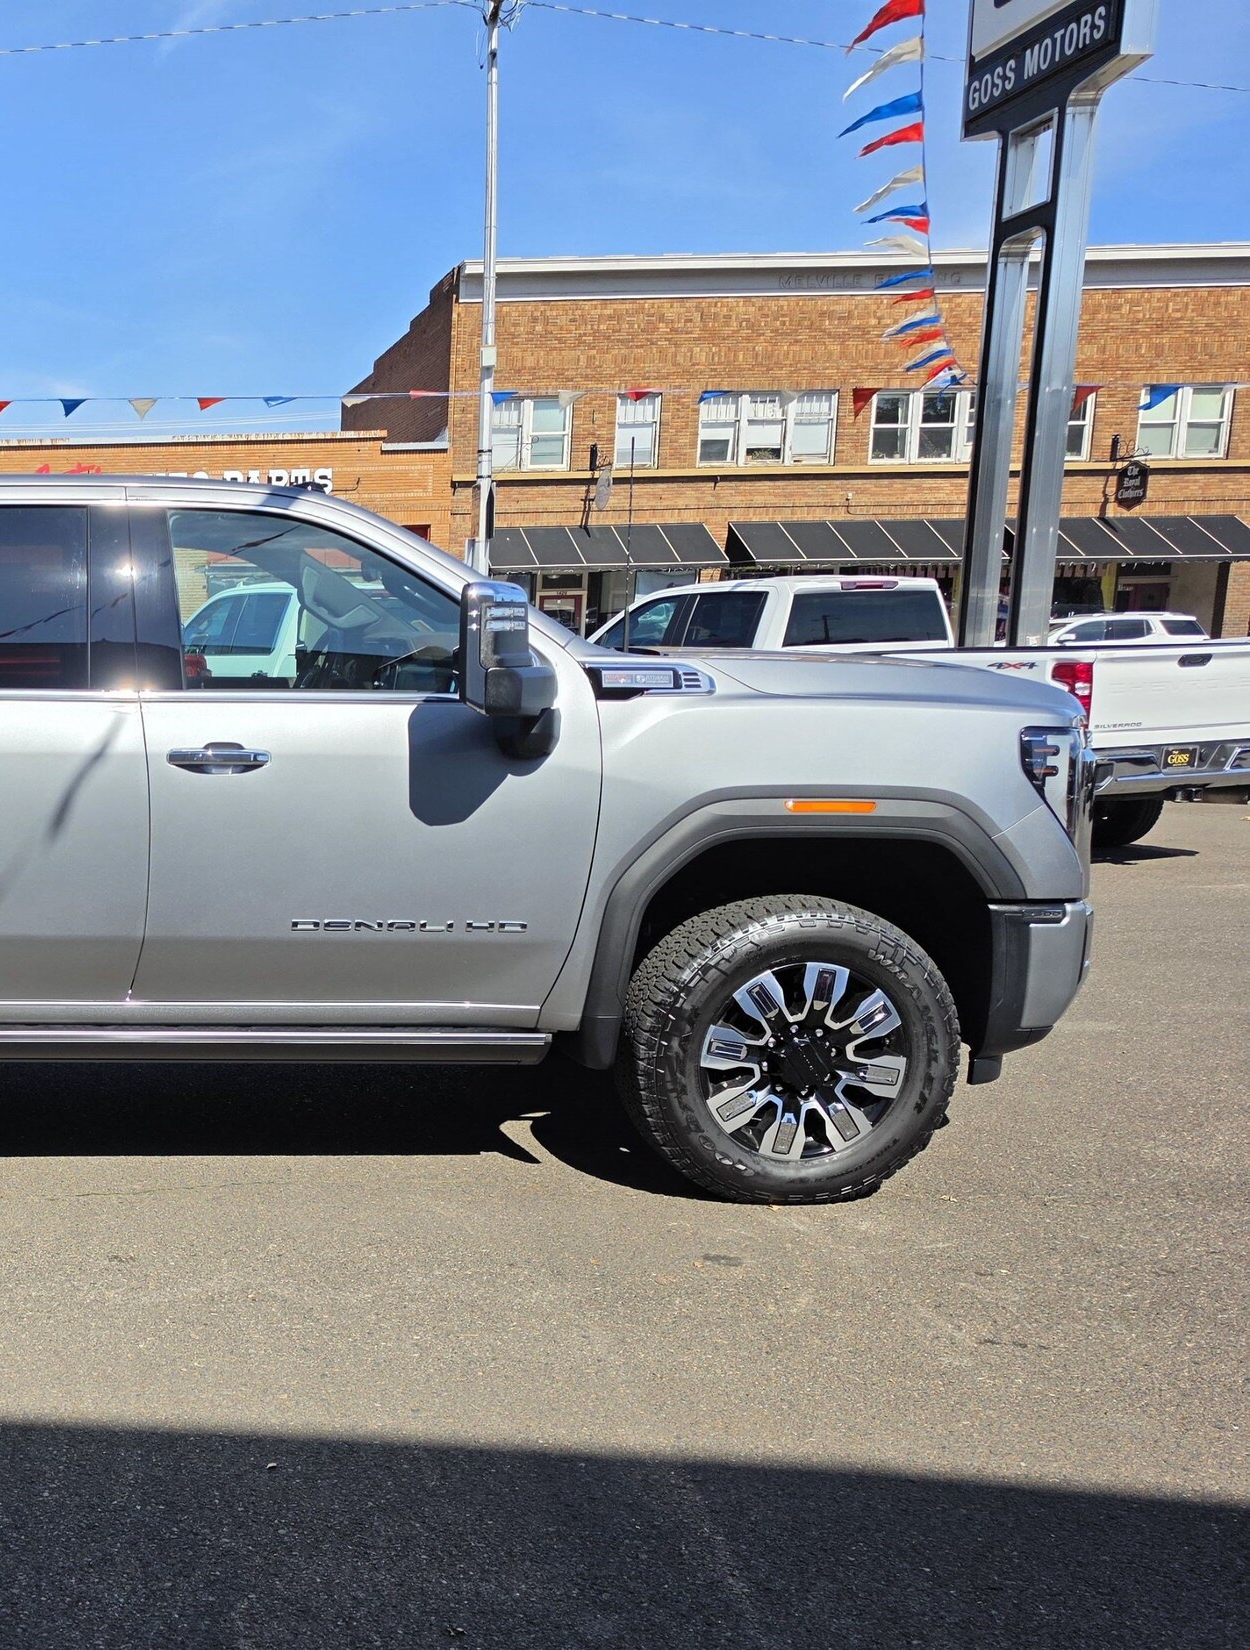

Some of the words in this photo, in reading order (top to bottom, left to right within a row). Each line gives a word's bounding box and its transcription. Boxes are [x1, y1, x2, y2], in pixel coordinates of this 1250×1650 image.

[969, 59, 1016, 111] GOSS
[1023, 5, 1106, 80] MOTORS
[778, 273, 862, 289] MELVILLE
[1093, 722, 1142, 730] SILVERADO
[1167, 753, 1190, 764] GOSS
[291, 919, 454, 932] DENALI
[465, 920, 528, 933] HD
